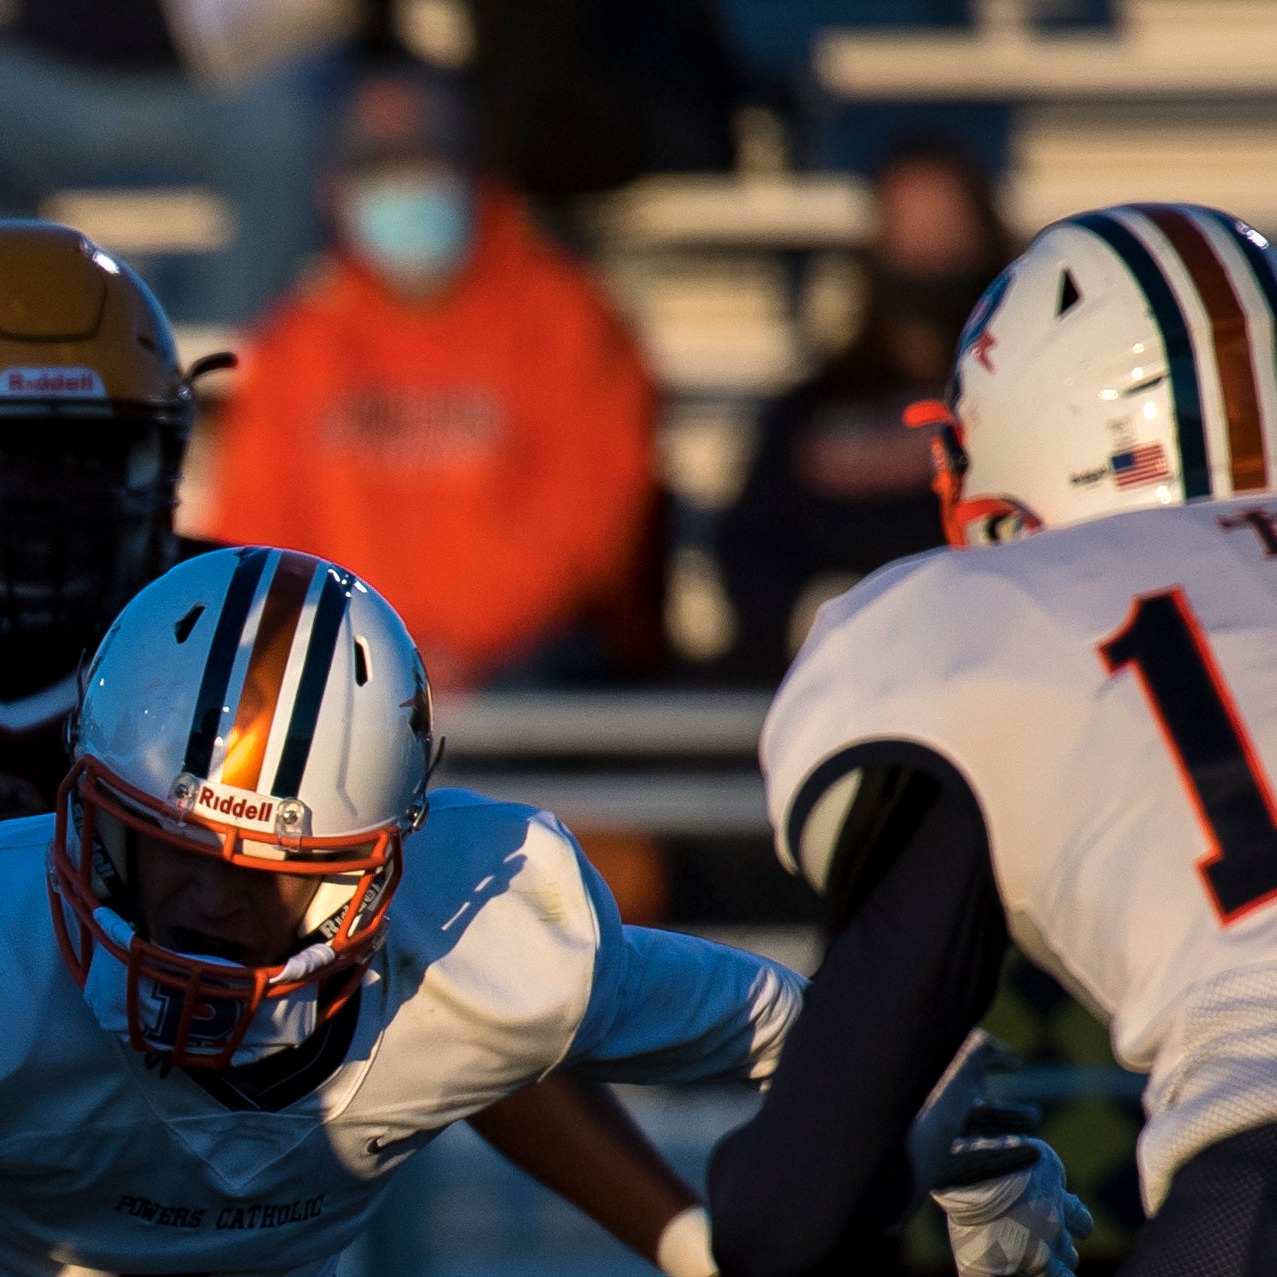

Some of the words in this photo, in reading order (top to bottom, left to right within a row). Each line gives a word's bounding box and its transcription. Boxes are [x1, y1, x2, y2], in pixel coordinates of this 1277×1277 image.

[9, 373, 94, 392] Riddell
[1097, 584, 1277, 928] 1
[199, 786, 273, 822] Riddell
[115, 1194, 206, 1229] POWERS
[215, 1194, 326, 1230] CATHOLIC
